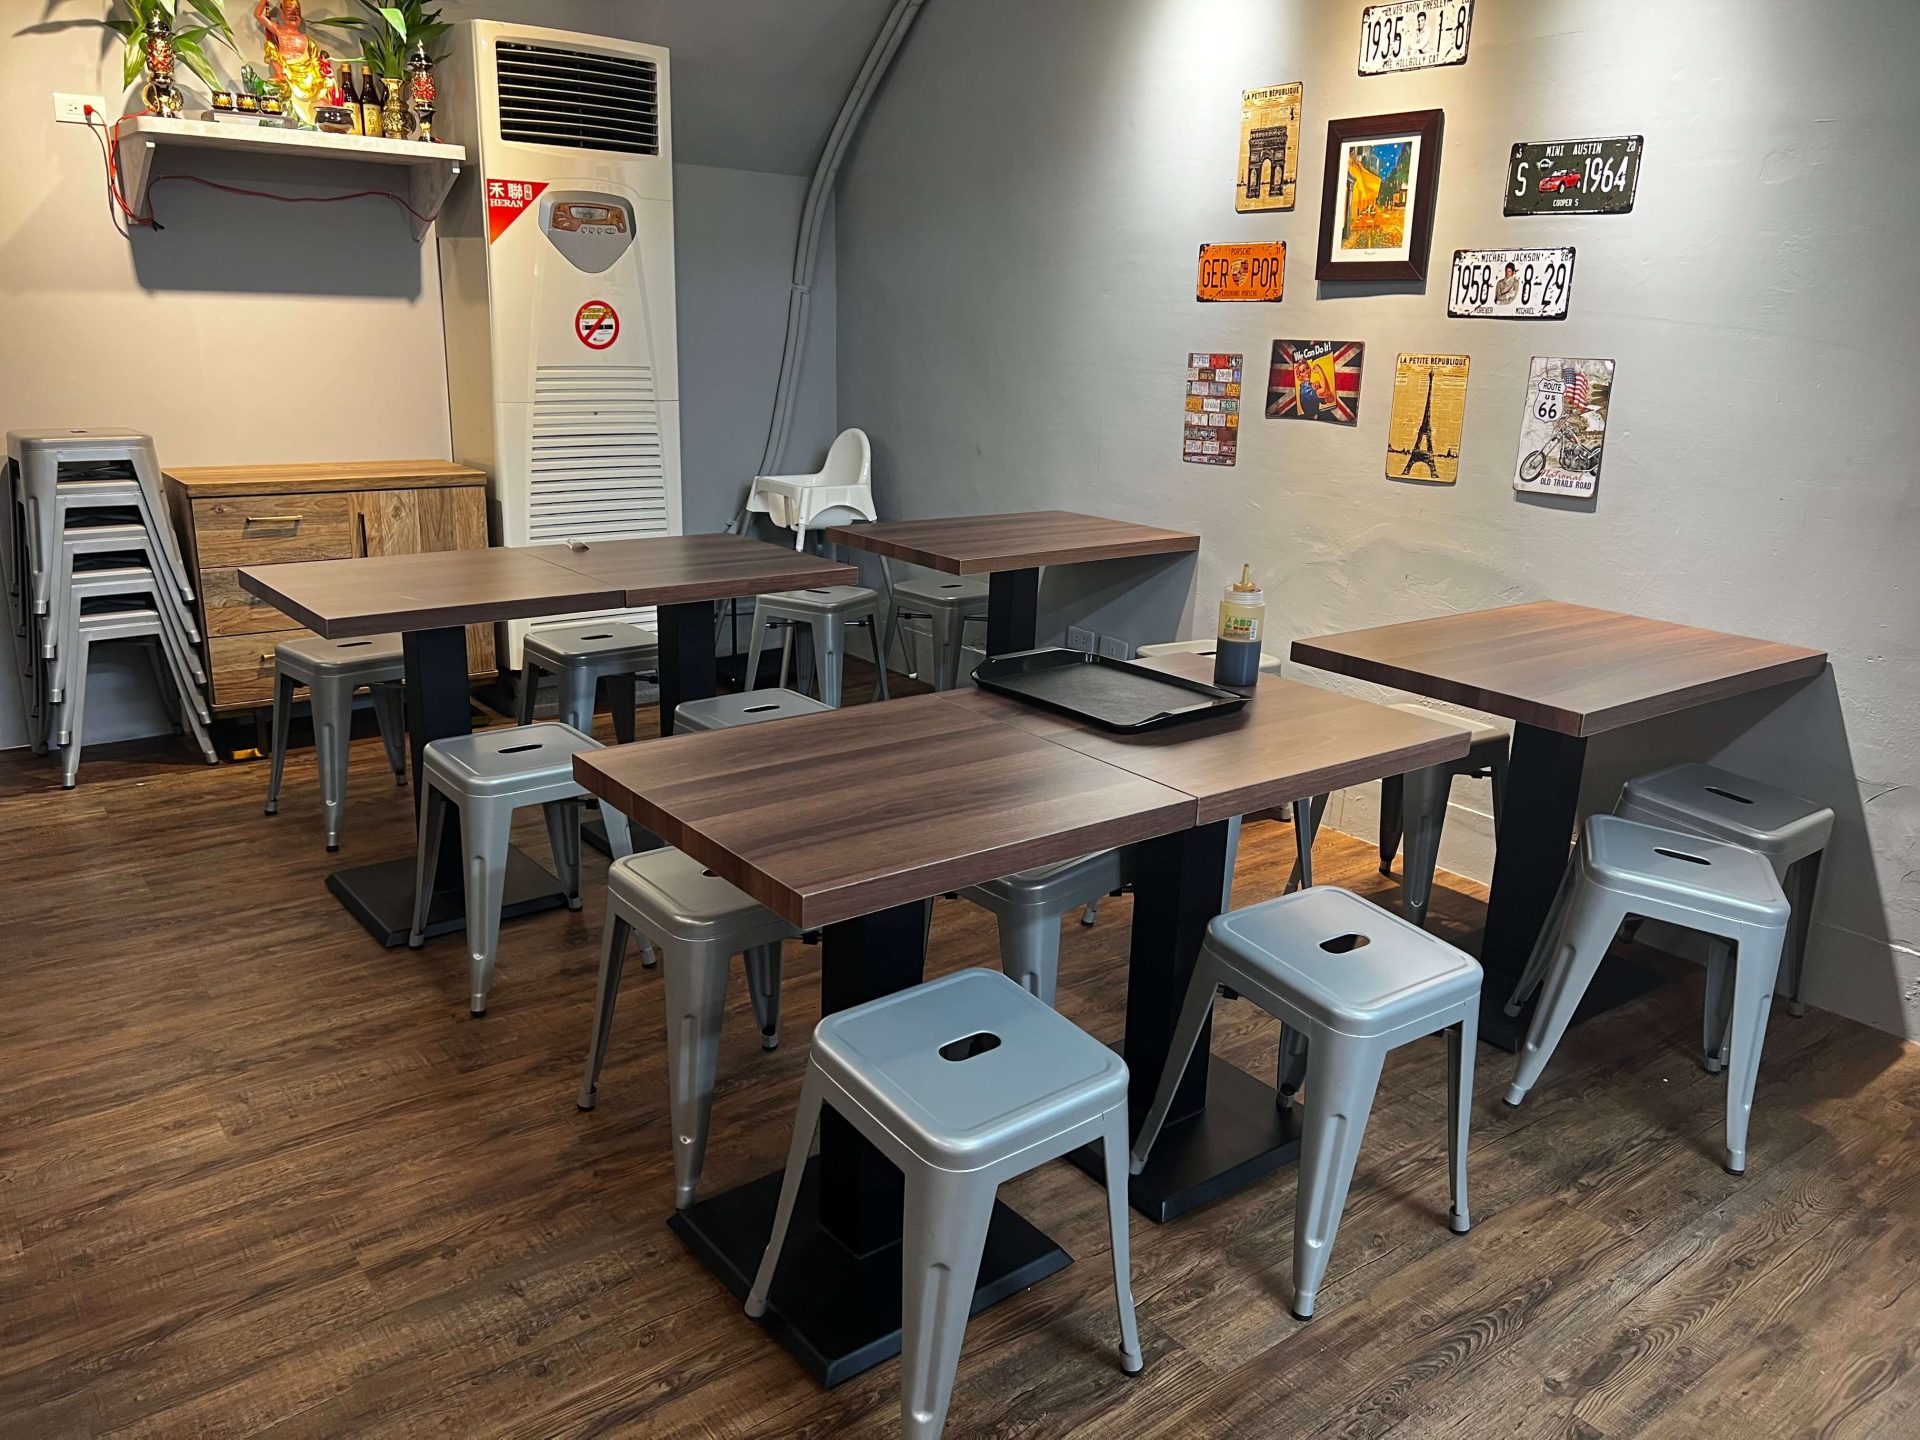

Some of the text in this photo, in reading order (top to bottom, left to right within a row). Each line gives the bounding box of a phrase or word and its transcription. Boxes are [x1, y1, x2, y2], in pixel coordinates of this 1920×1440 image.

[1366, 5, 1466, 62] 1935 1-8
[1428, 54, 1440, 63] CAT
[1243, 93, 1250, 101] LA
[1251, 90, 1267, 100] PETITE
[1545, 142, 1602, 157] MINI AUSTIN
[1514, 156, 1629, 197] S 1964
[489, 182, 523, 199] 禾聯
[490, 199, 523, 208] HERAN
[1552, 198, 1579, 207] COOPER S
[1480, 252, 1540, 263] MICHAEL JACKSON
[1202, 257, 1279, 288] GER POR
[1456, 263, 1566, 306] 1958 8-29
[1515, 307, 1535, 315] MICHAEL
[1294, 350, 1303, 361] We
[1303, 348, 1315, 359] Can
[1315, 344, 1323, 355] Do
[1409, 357, 1429, 366] PETITE
[1543, 382, 1562, 392] ROUTE
[1538, 402, 1557, 419] 66
[1540, 477, 1592, 490] OLD TRAILS ROAD
